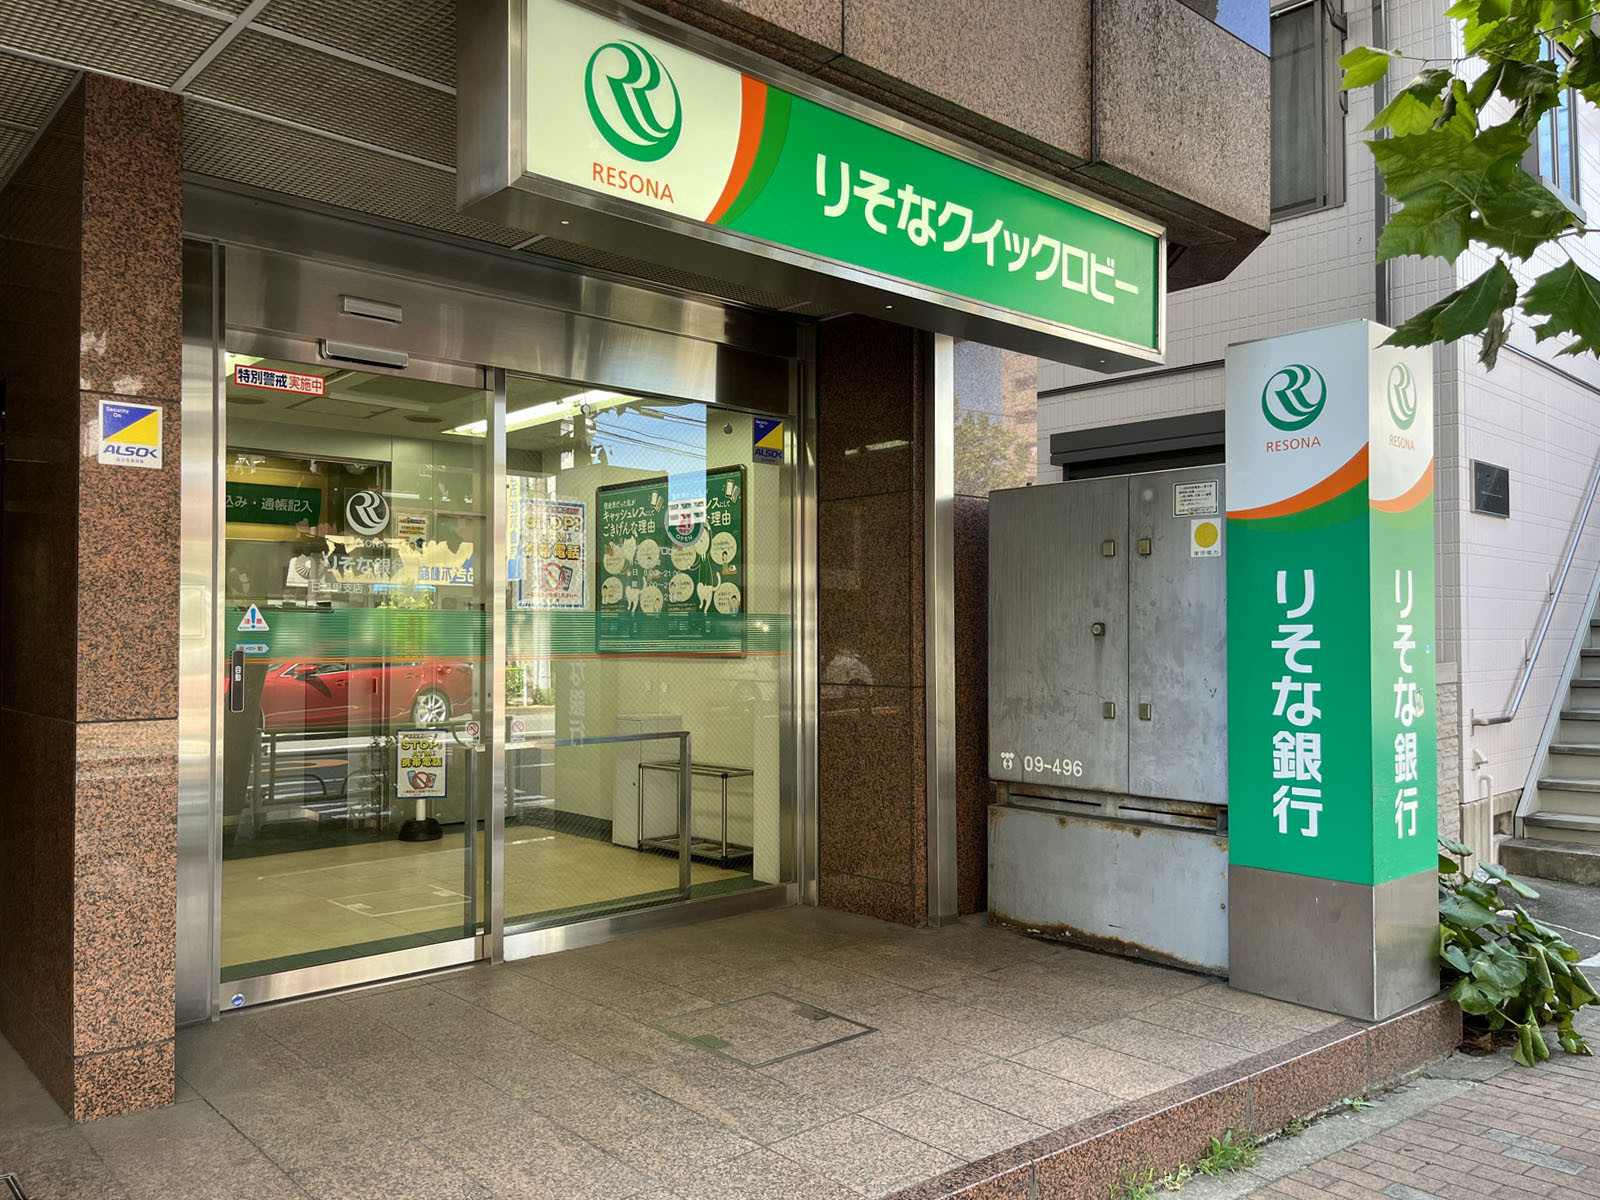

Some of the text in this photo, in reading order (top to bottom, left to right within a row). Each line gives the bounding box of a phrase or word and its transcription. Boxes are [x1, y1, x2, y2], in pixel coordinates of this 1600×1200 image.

[592, 161, 675, 204] RESONA
[815, 152, 1139, 305] りそなクイックロビー
[237, 368, 322, 393] 特別警戒実施中
[103, 445, 158, 458] ALSOK
[755, 448, 784, 459] ALSOK
[1266, 435, 1321, 453] RESONA
[1389, 434, 1415, 451] RESONA
[676, 534, 693, 542] OPEN
[1271, 569, 1323, 838] りそな銀行
[1393, 569, 1418, 839] りそな銀行
[1024, 755, 1083, 777] 09-496
